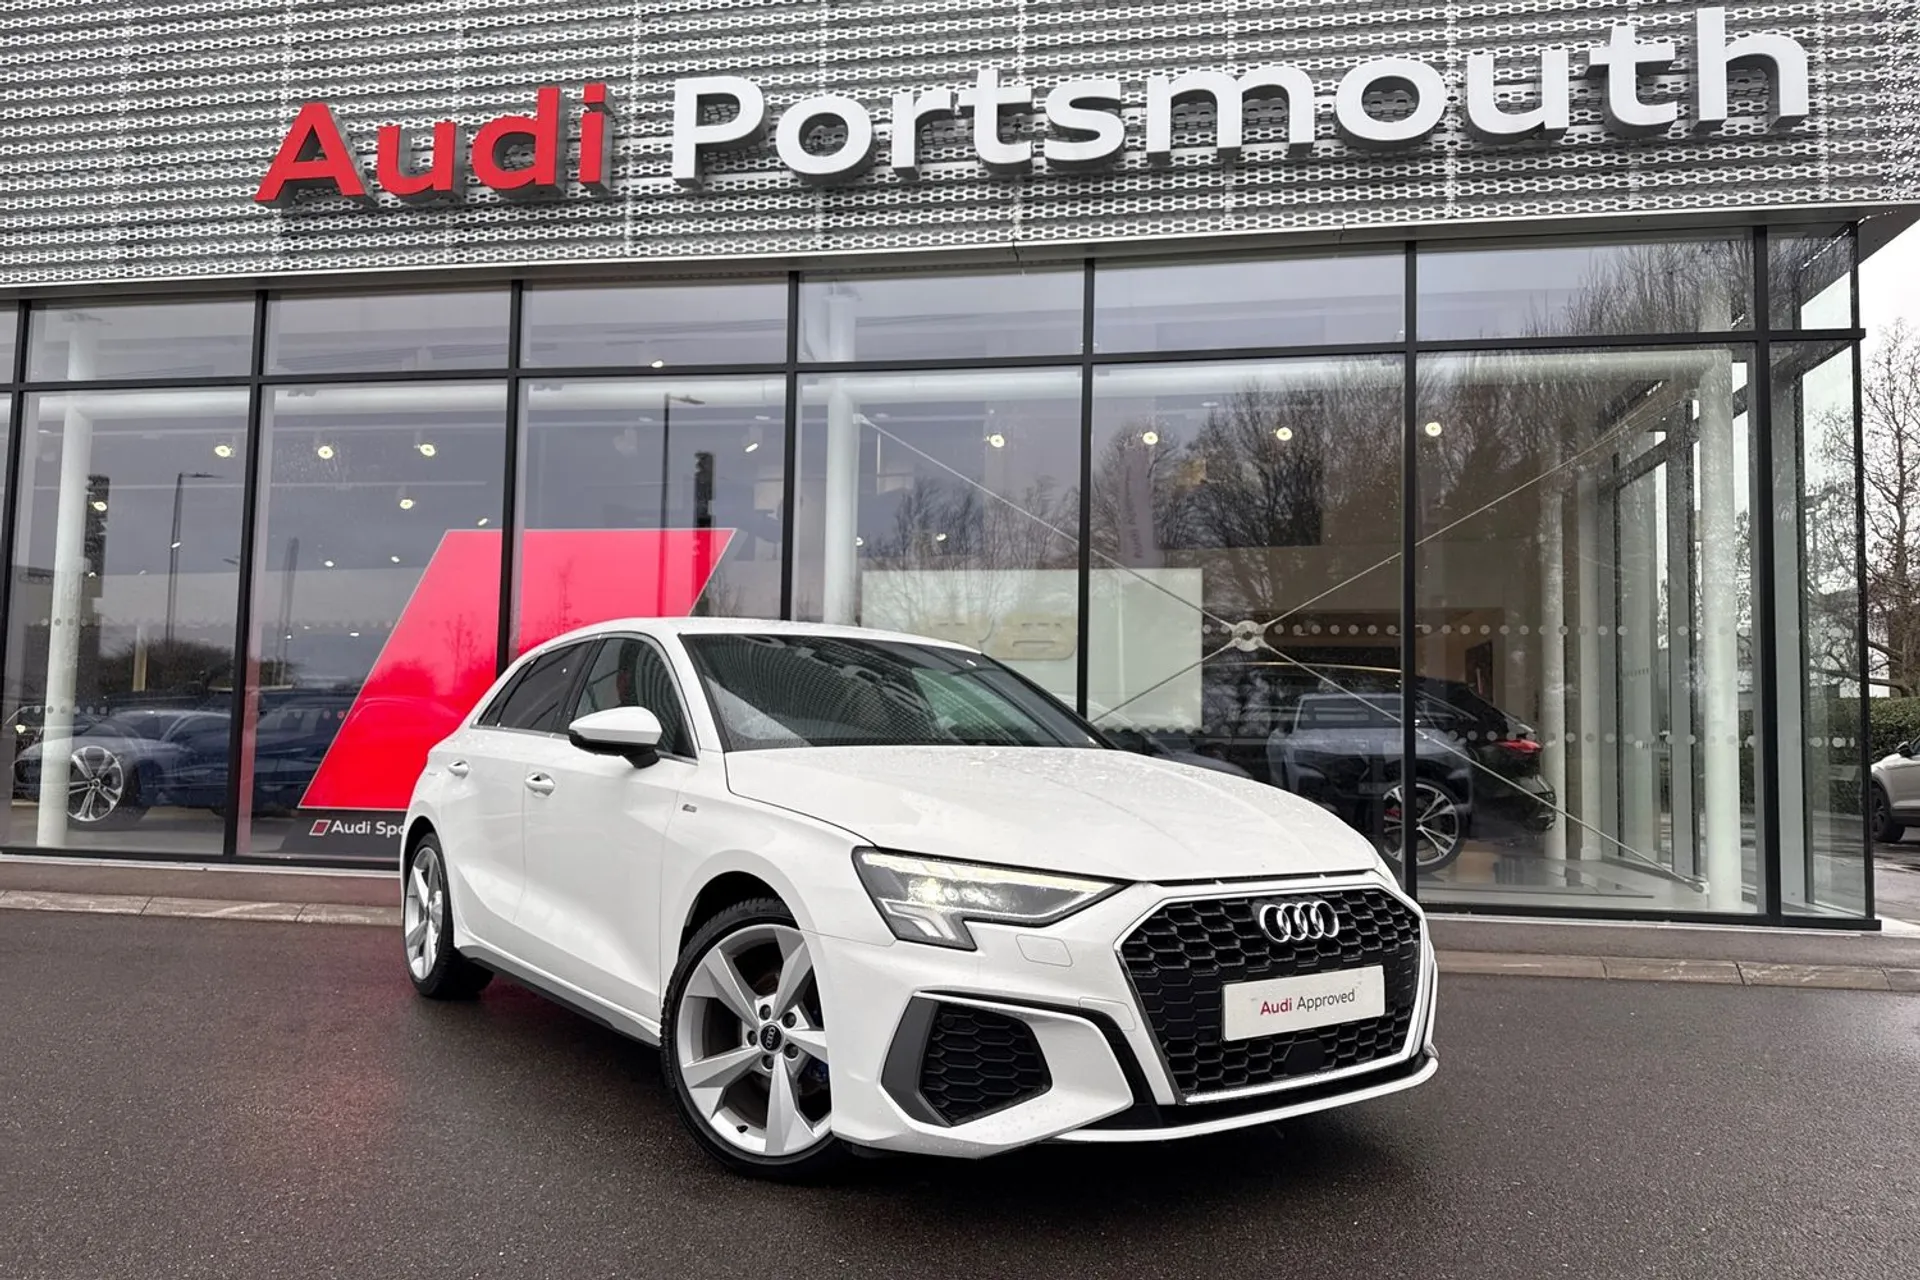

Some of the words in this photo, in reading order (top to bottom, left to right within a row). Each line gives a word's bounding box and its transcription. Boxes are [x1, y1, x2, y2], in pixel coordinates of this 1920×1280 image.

[255, 84, 613, 203] Audi
[671, 8, 1811, 186] Portsmouth
[331, 820, 371, 834] Audi
[1260, 997, 1292, 1016] Audi
[1296, 989, 1356, 1012] Approved
